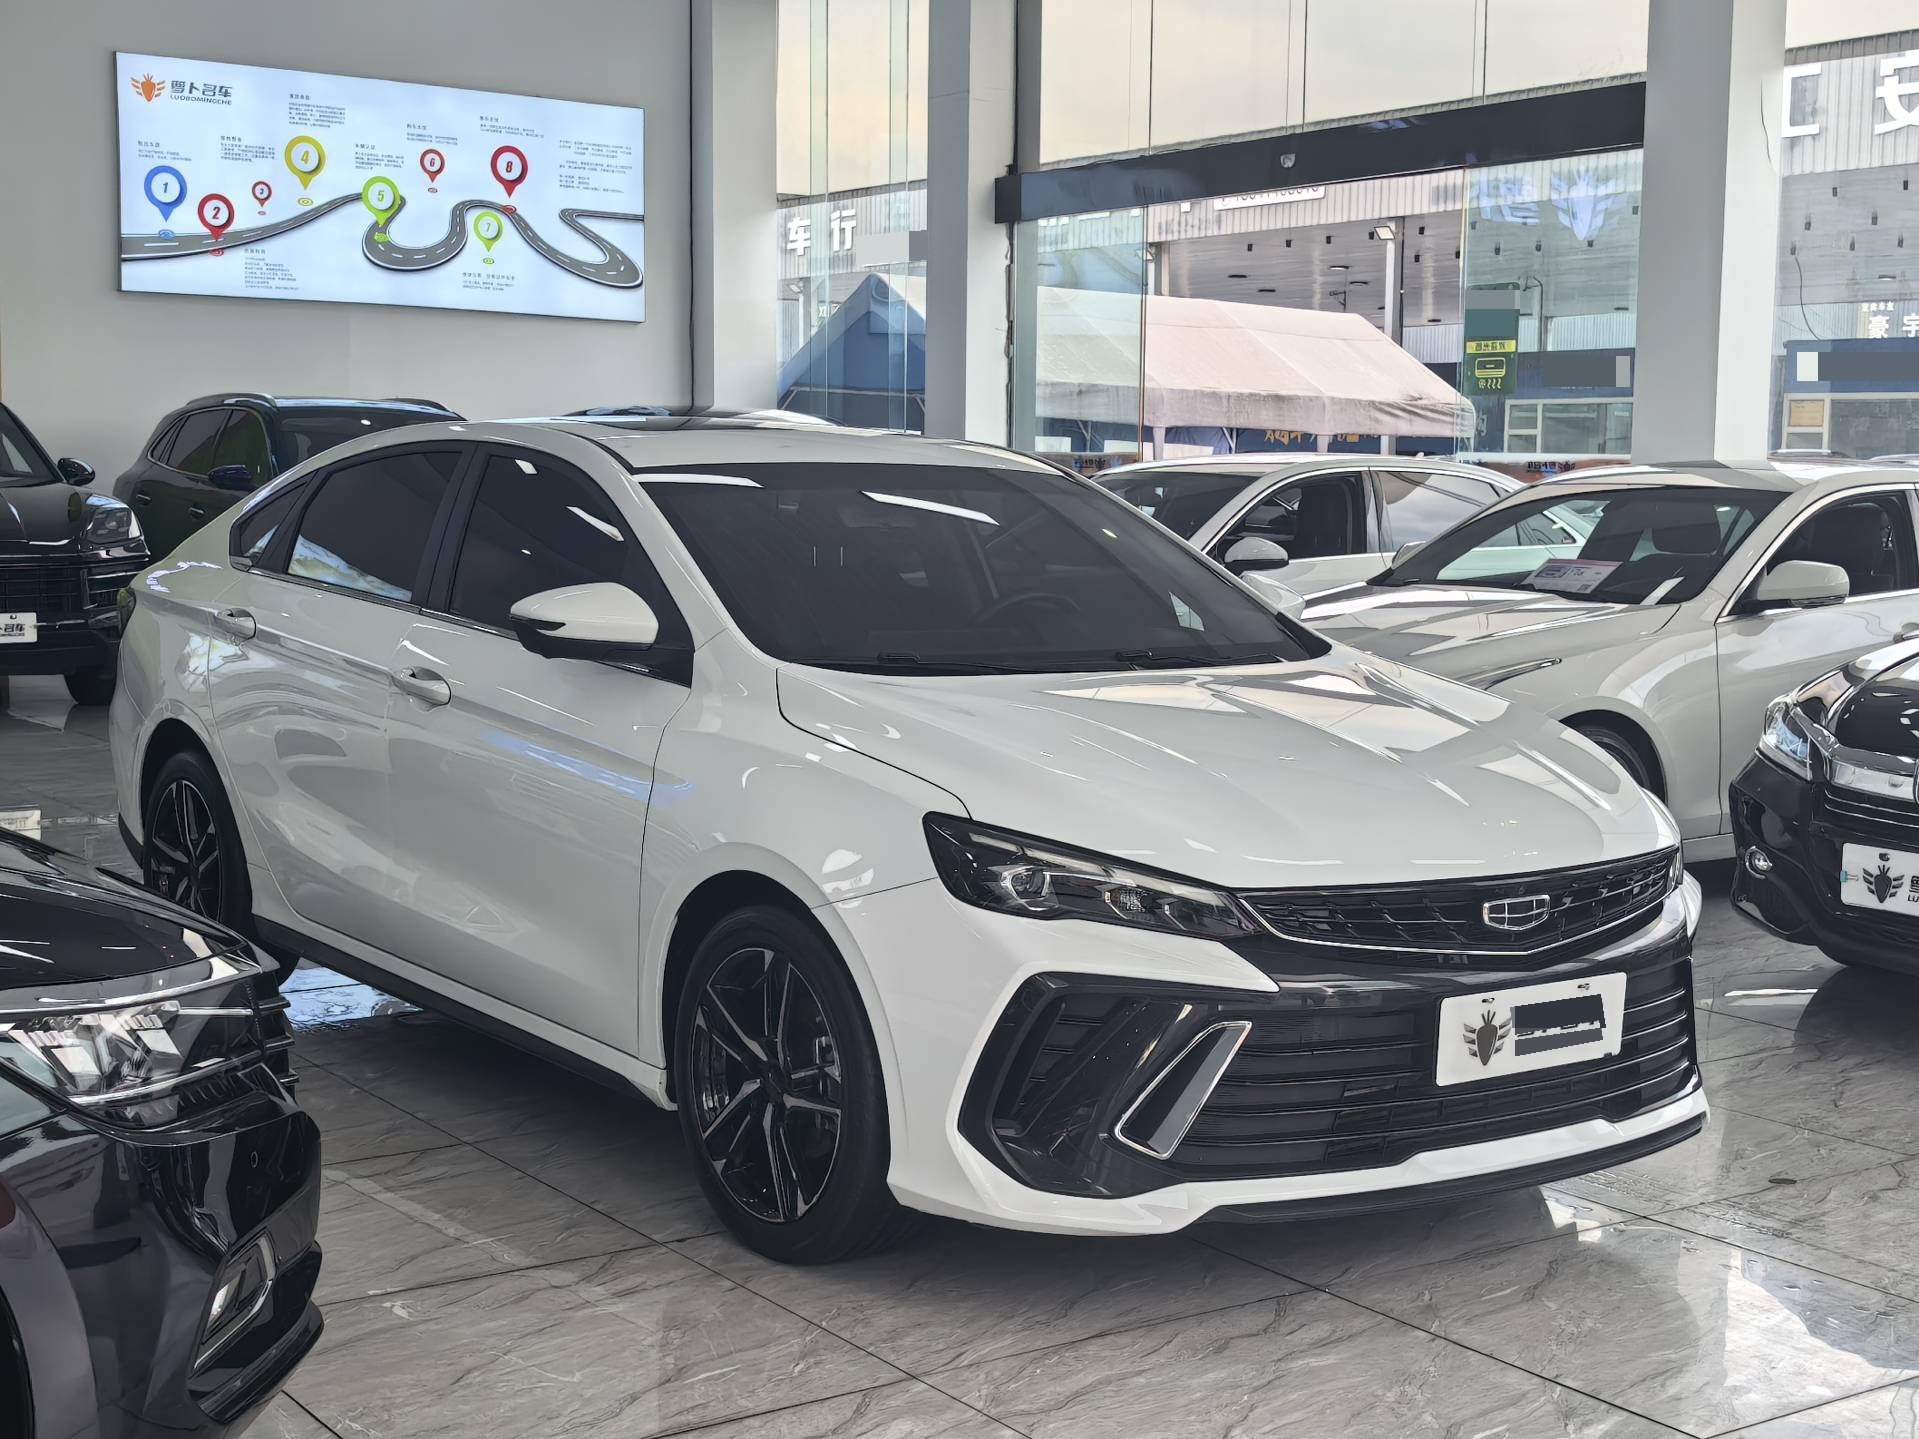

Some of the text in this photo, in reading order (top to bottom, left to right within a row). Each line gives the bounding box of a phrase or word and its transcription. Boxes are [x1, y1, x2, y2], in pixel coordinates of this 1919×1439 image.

[301, 150, 310, 164] 4
[505, 160, 513, 173] 8
[162, 182, 169, 193] 1
[377, 190, 385, 202] 5
[212, 206, 221, 219] 2
[484, 222, 492, 233] 7
[787, 209, 857, 256] 车行
[0, 623, 26, 632] 名车
